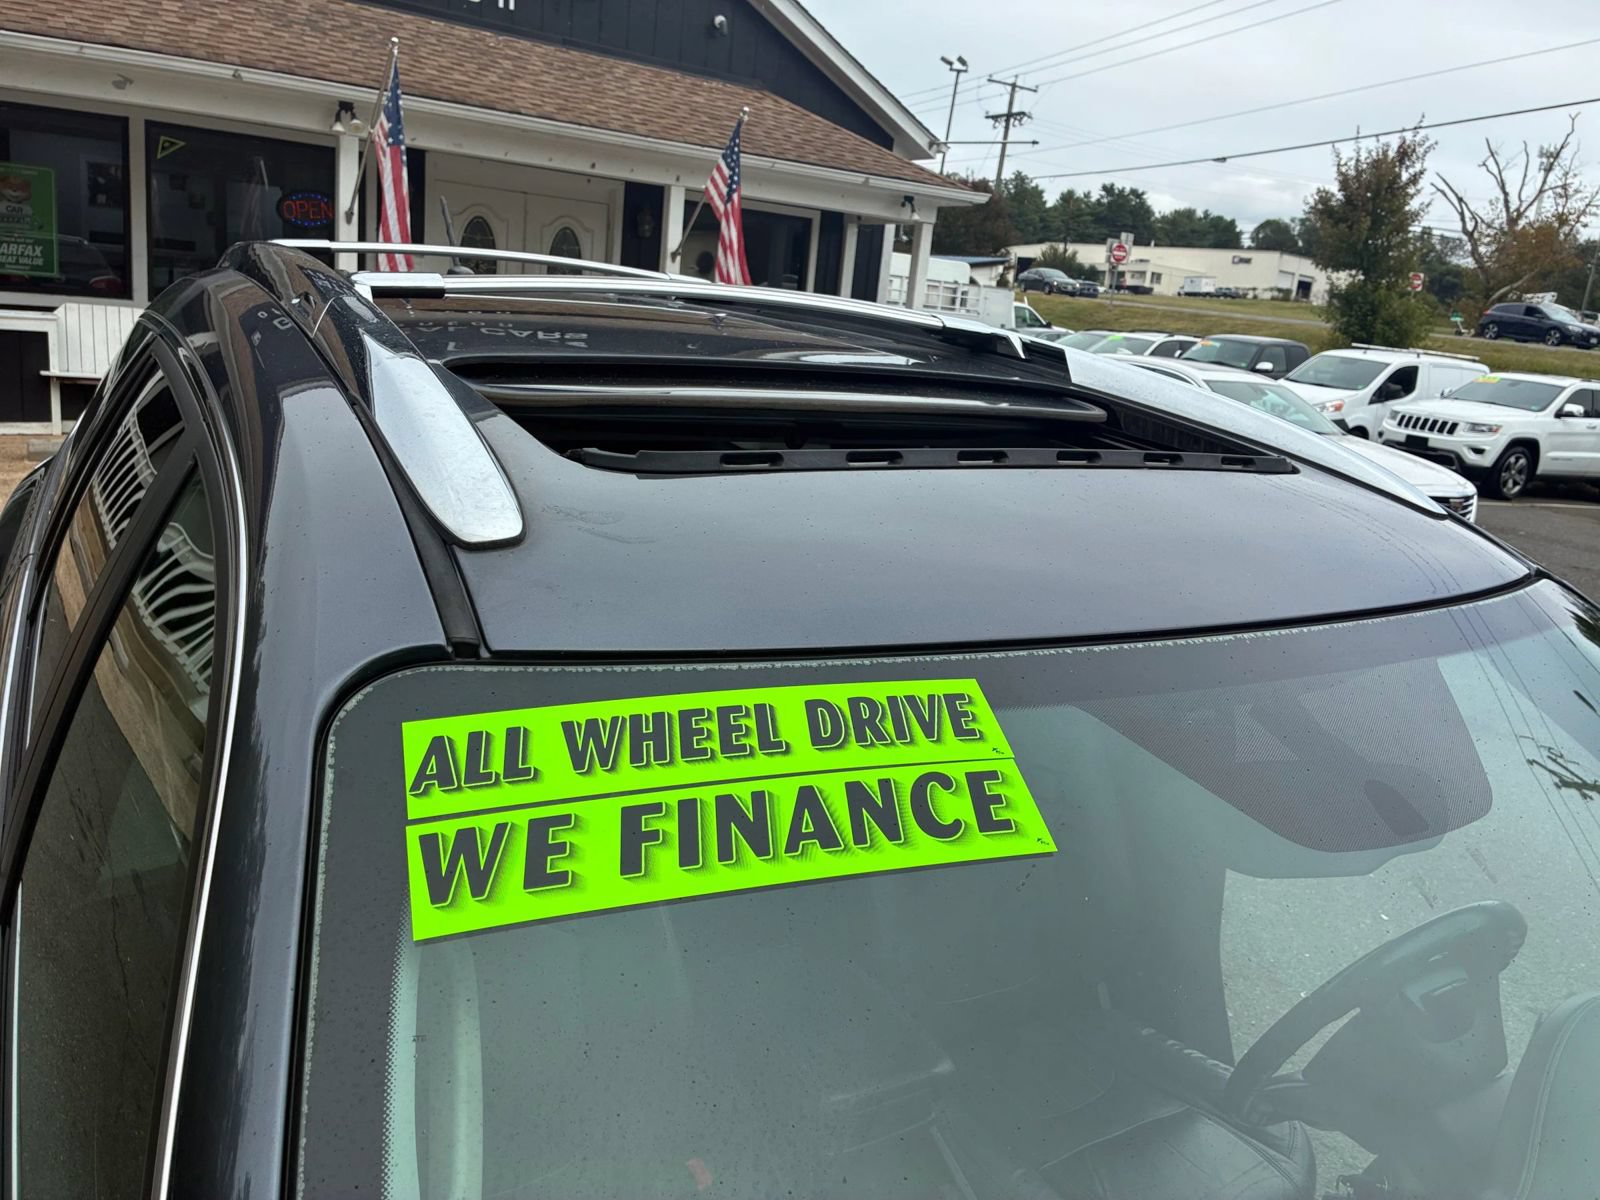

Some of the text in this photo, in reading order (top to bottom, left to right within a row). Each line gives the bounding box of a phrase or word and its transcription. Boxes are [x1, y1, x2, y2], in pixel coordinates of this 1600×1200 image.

[284, 200, 334, 219] OPEN
[0, 243, 43, 257] ARFAX
[409, 692, 983, 796] ALL WHEEL DRIVE
[418, 769, 1018, 909] WE FINANCE
